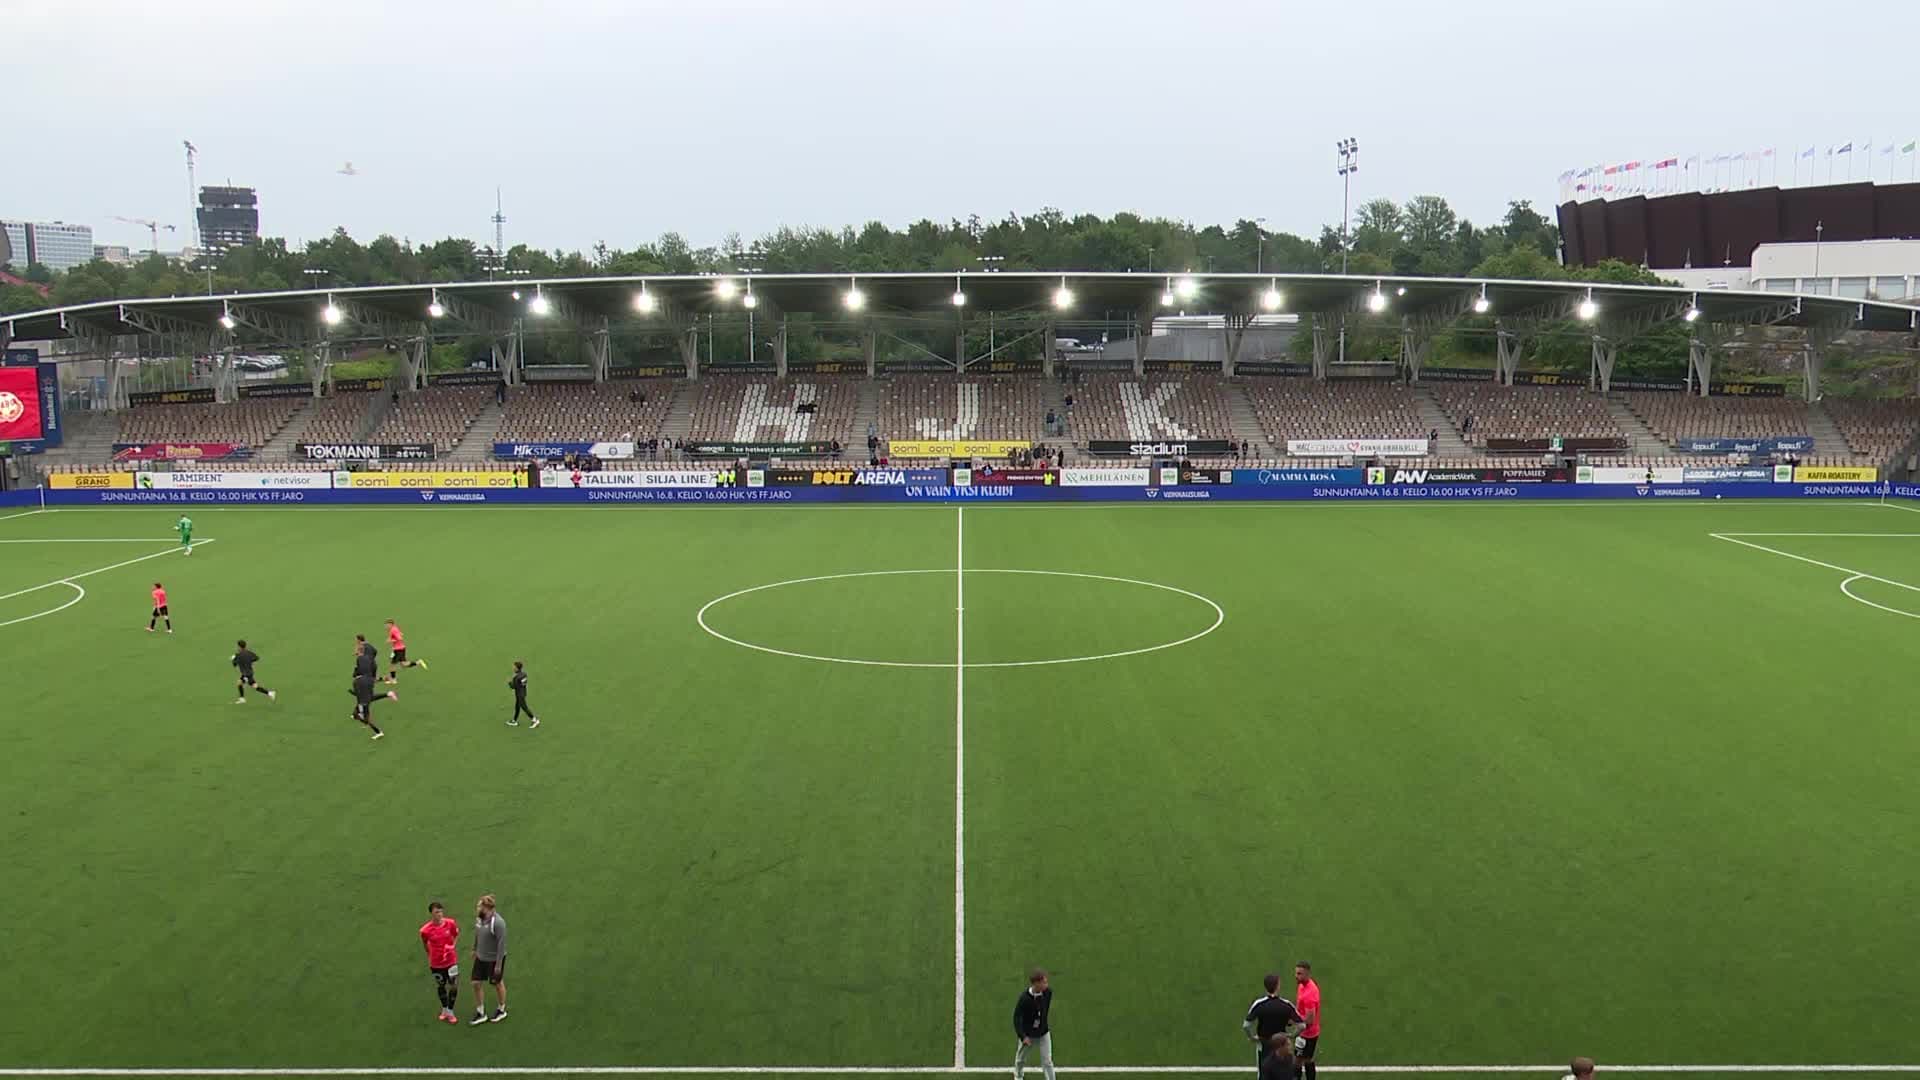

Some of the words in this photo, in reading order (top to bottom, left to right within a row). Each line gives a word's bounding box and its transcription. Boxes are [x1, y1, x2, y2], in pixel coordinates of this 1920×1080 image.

[303, 445, 380, 458] TOKMANNI
[513, 445, 534, 456] HJK
[534, 447, 563, 456] STORE
[893, 444, 920, 453] oomi
[928, 444, 955, 453] oomi
[963, 444, 991, 453] oomi
[1129, 443, 1188, 455] stadium
[172, 473, 223, 483] RAMIRENT
[273, 476, 311, 485] netvisor
[356, 475, 389, 487] oomi
[400, 475, 433, 487] oomi
[444, 475, 478, 486] oomi
[585, 475, 635, 484] TALLINK
[646, 475, 677, 484] SILJA
[680, 474, 707, 484] LINE
[812, 471, 854, 485] BOLT
[854, 471, 906, 485] ARENA
[1271, 473, 1308, 481] MAMMA
[1309, 473, 1336, 481] ROSA
[1807, 472, 1827, 480] KAFFA
[1827, 472, 1862, 480] ROASTERY
[75, 478, 111, 486] GRANO
[588, 491, 654, 500] SUNNUNTAINA
[656, 491, 675, 500] 16.8.
[677, 491, 702, 500] KELLO
[705, 490, 728, 499] 16.00
[729, 490, 745, 499] HJK
[747, 490, 757, 499] VS
[759, 490, 768, 499] FF
[769, 490, 792, 499] JARO
[905, 485, 923, 497] ON
[925, 485, 951, 497] VAIN
[952, 485, 978, 497] YKSI
[981, 485, 1013, 497] KLUBI
[1313, 488, 1379, 497] SUNNUNTAINA
[1403, 487, 1428, 496] KELLO
[1430, 487, 1453, 496] 16.00
[1454, 487, 1470, 496] HJK
[1471, 487, 1483, 496] VS
[1484, 487, 1493, 496] FF
[1493, 487, 1518, 496] JARO
[1803, 486, 1871, 495] SUNNUNTAINA
[101, 492, 167, 501] SUNNUNTAINA
[190, 492, 215, 501] KELLO
[217, 491, 240, 500] 16.00
[241, 491, 257, 500] HJK
[258, 491, 270, 500] VS
[271, 491, 279, 500] FF
[281, 491, 304, 500] JARO
